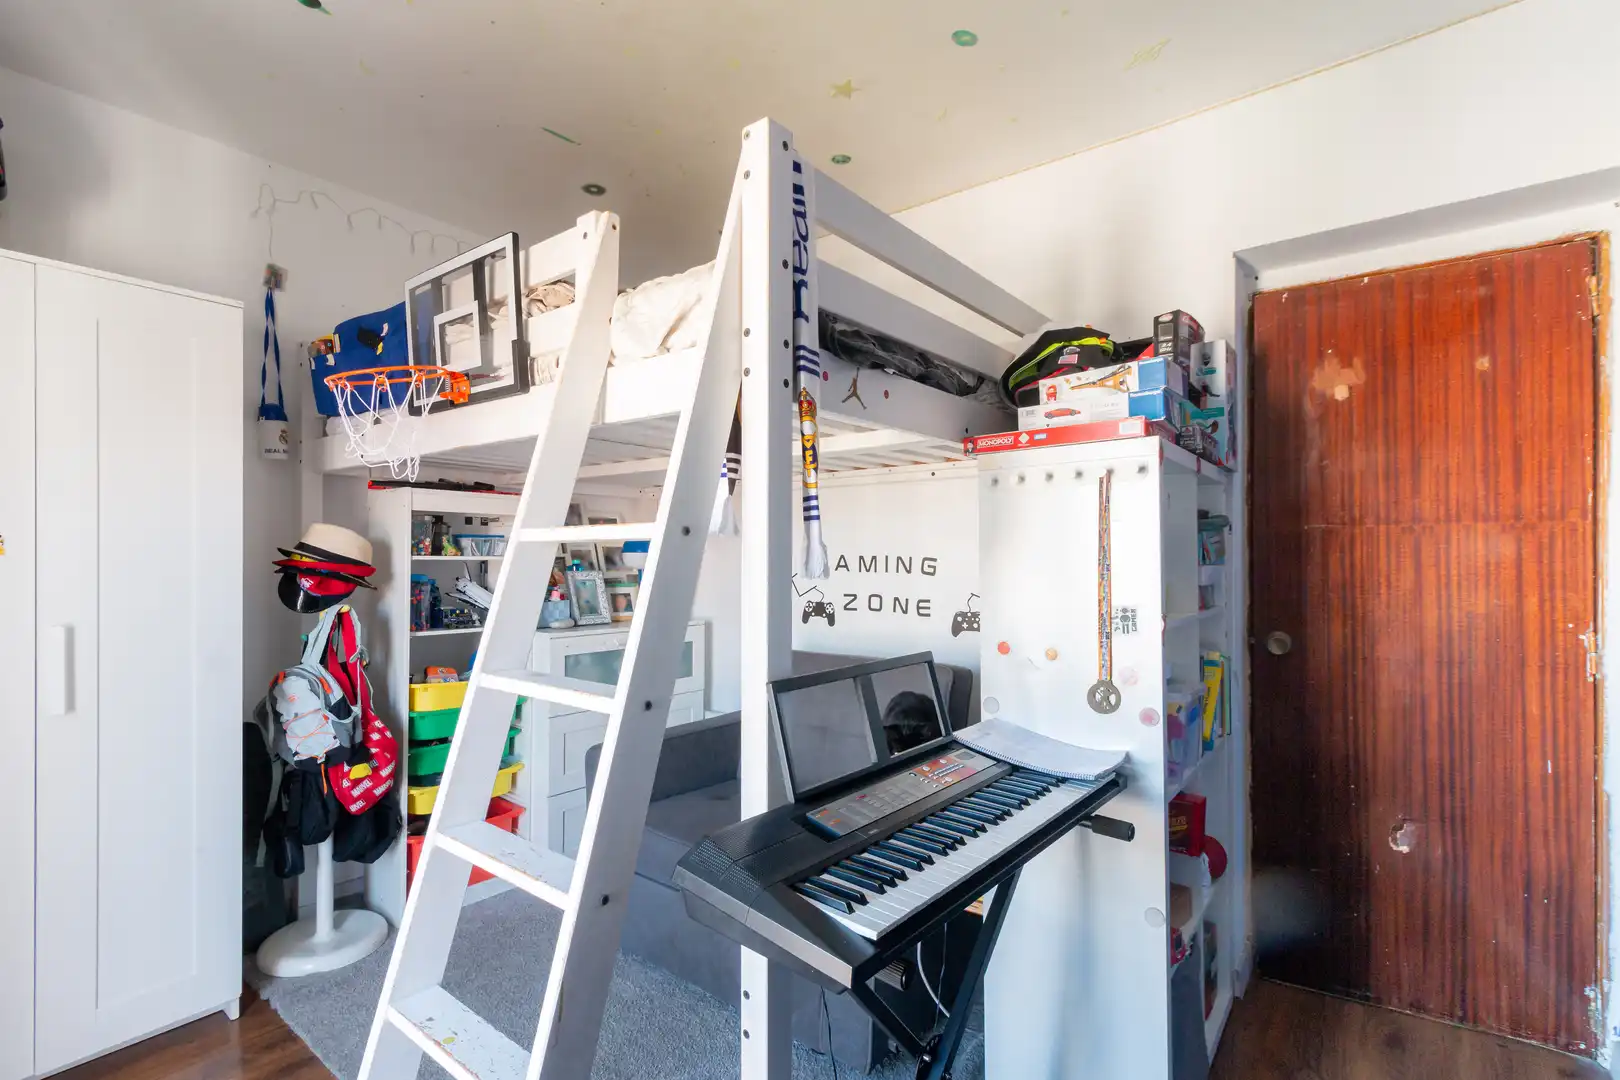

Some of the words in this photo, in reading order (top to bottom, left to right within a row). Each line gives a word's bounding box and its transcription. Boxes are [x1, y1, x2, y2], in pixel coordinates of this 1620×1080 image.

[977, 437, 1013, 448] MONOPOLY
[834, 554, 938, 577] AMING
[843, 593, 931, 617] ZONE
[350, 778, 373, 798] MARVEL
